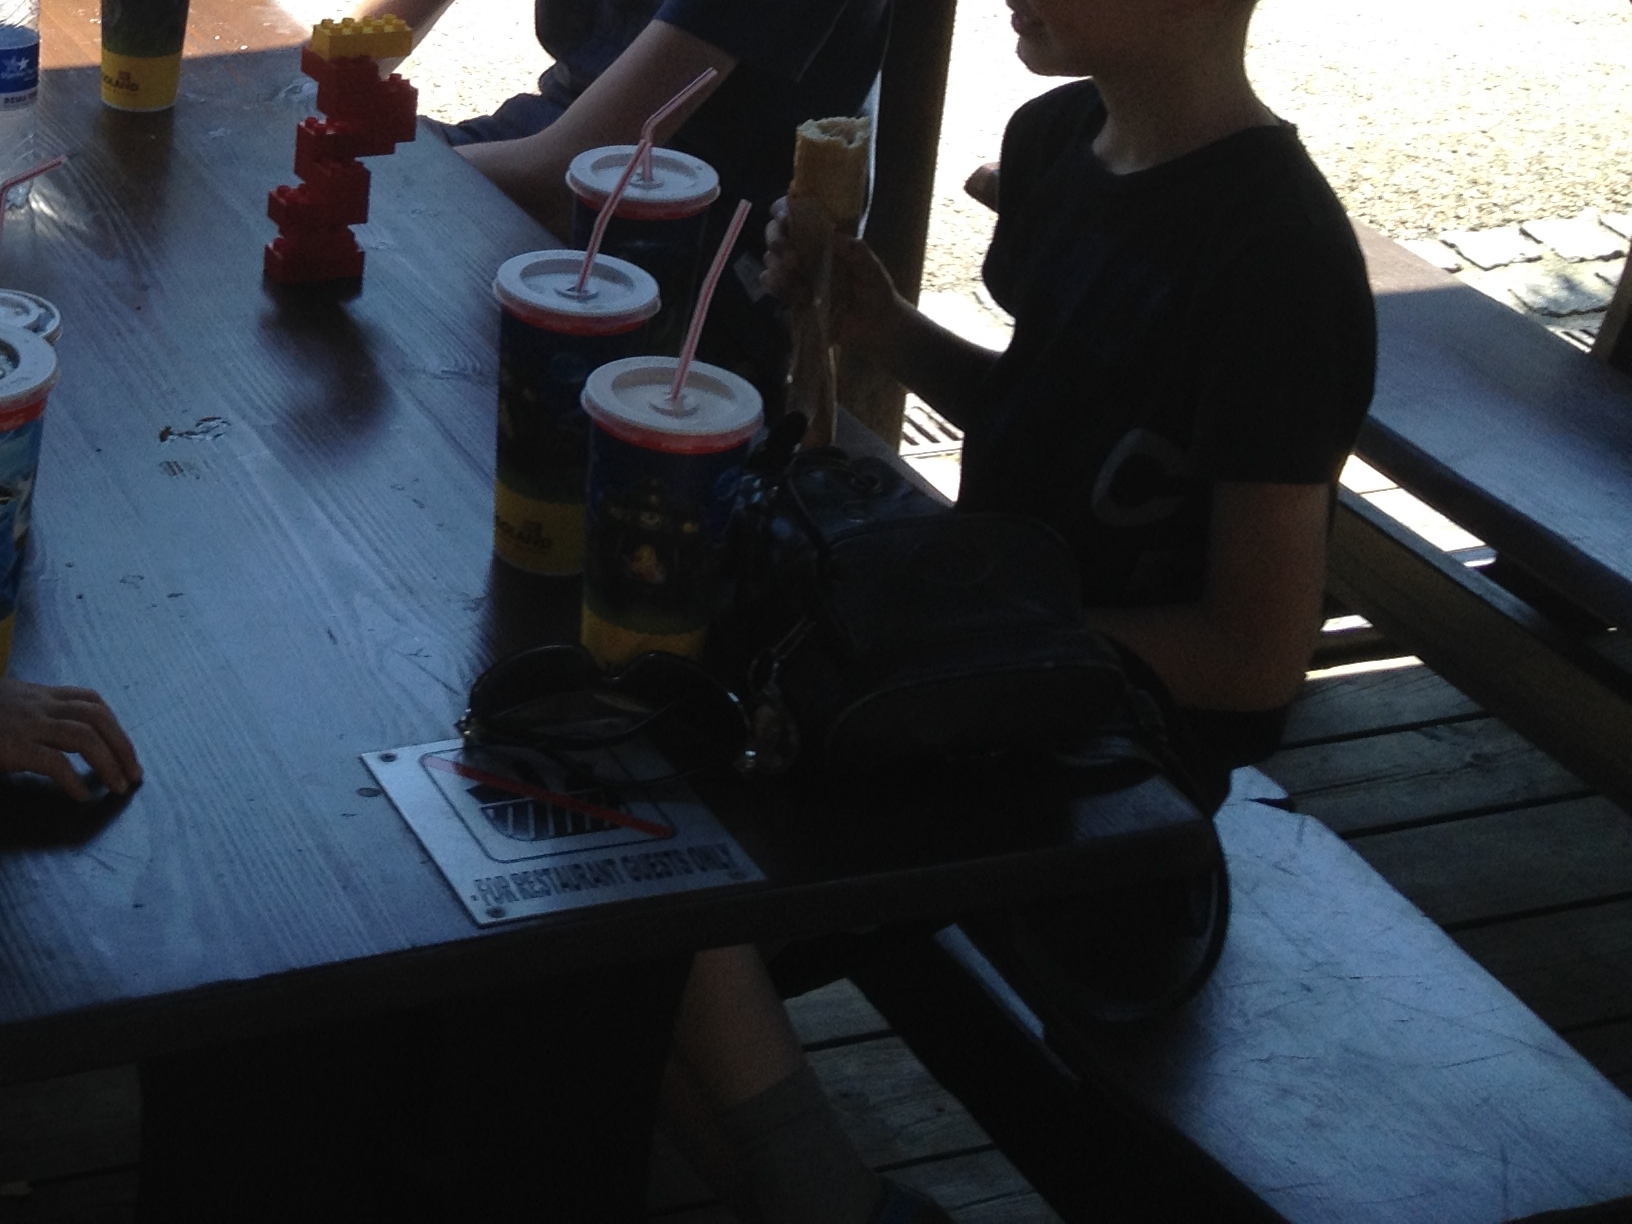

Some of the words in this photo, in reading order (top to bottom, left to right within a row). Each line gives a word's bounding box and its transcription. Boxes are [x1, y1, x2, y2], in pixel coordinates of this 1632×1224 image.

[474, 875, 519, 907] FOR
[510, 858, 625, 900] RESTAURANT
[621, 849, 693, 882] GUESTS
